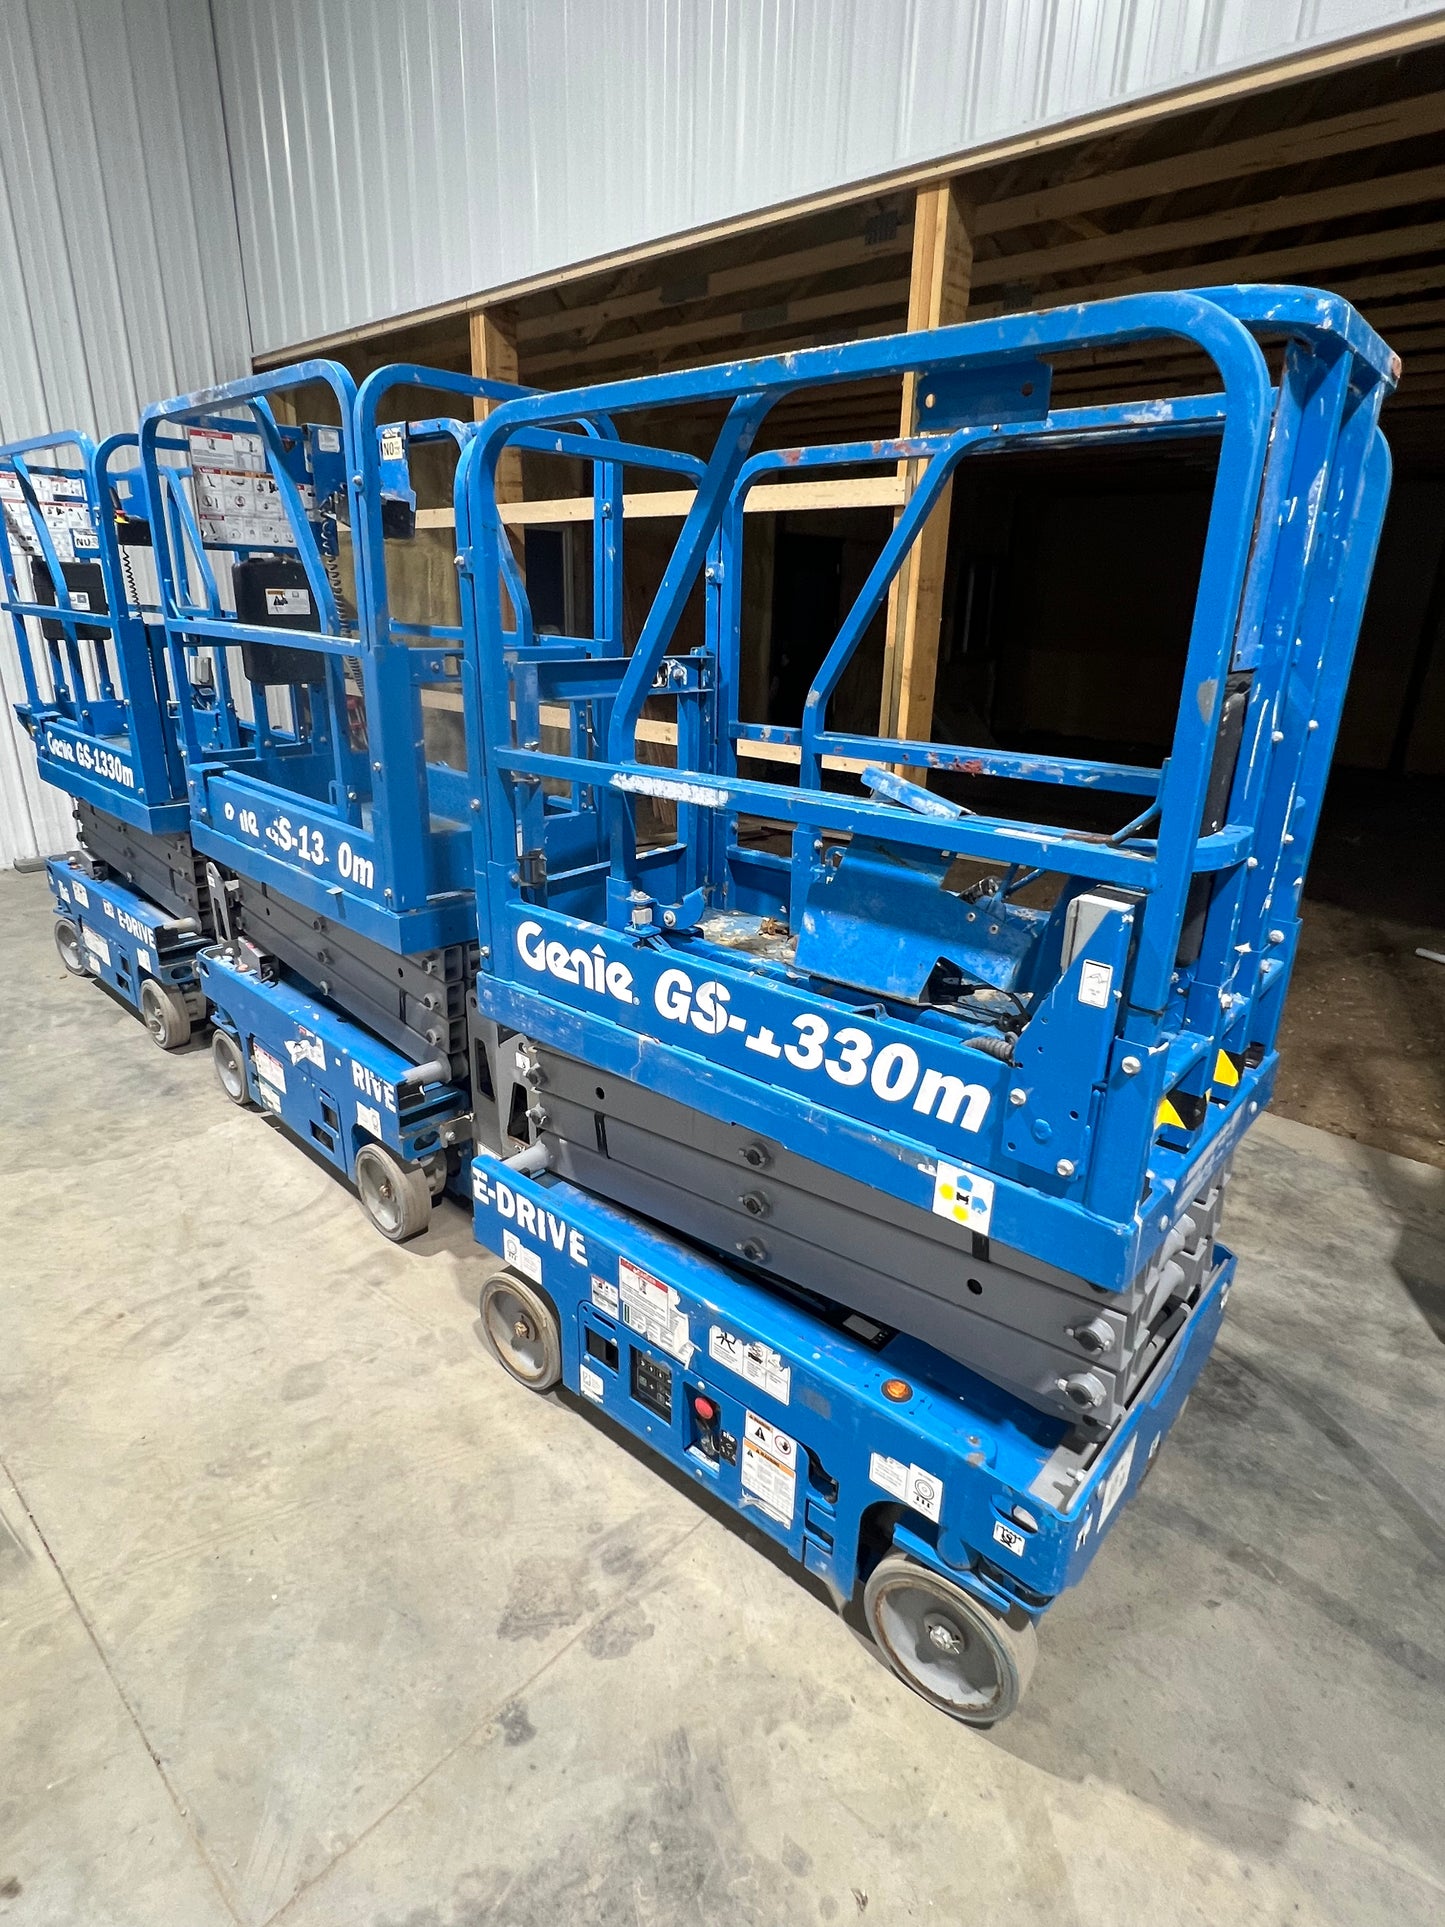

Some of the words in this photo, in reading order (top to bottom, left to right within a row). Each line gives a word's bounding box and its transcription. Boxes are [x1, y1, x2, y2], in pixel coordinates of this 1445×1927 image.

[76, 740, 135, 789] GS-1330m
[117, 907, 157, 950] E-DRIVE
[516, 920, 635, 1005] Genie
[472, 1165, 588, 1268] E-DRIVE
